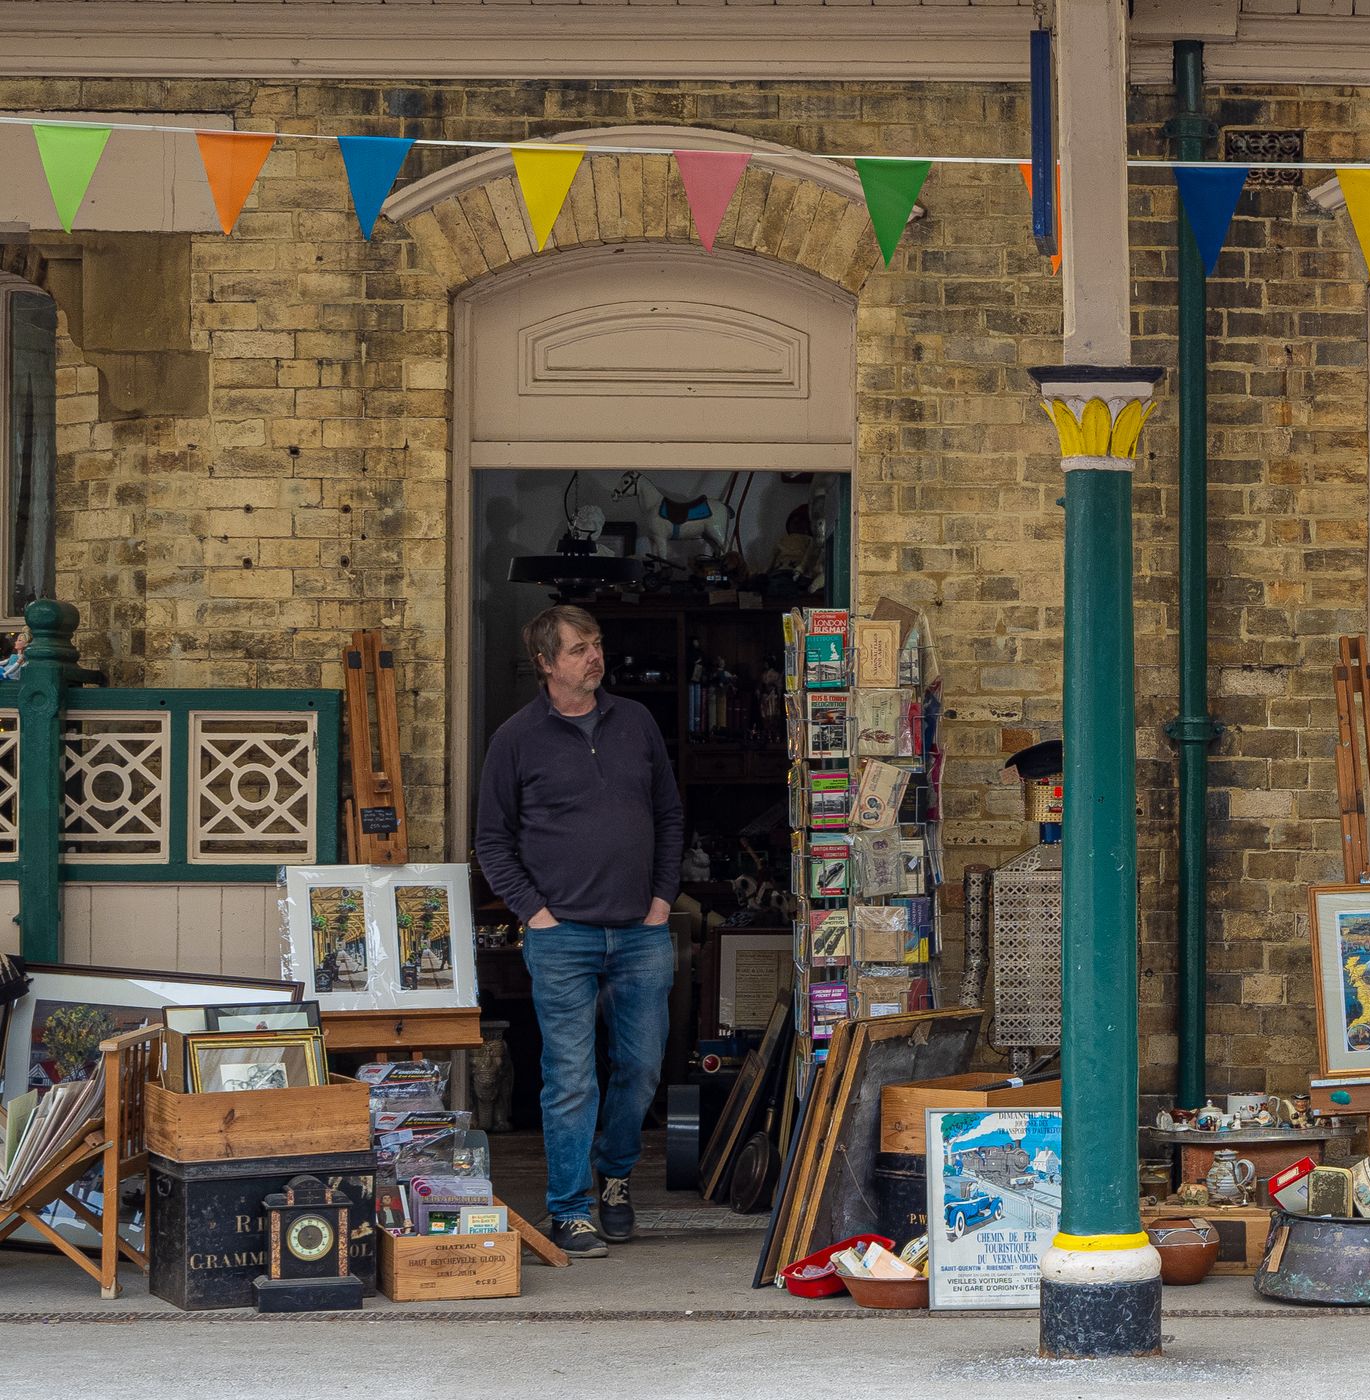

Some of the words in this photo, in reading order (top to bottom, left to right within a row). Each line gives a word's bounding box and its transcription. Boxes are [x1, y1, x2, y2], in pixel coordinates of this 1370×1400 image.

[813, 619, 847, 627] LONDON
[977, 1232, 1005, 1243] CHEMIN
[1009, 1232, 1018, 1242] DE
[1024, 1231, 1037, 1242] FER
[984, 1242, 1030, 1254] TOURISTIQUE
[409, 1259, 428, 1267] HAUT
[480, 1255, 506, 1264] GLORIA
[978, 1254, 988, 1265] DU
[993, 1253, 1038, 1264] VERMANDOIS
